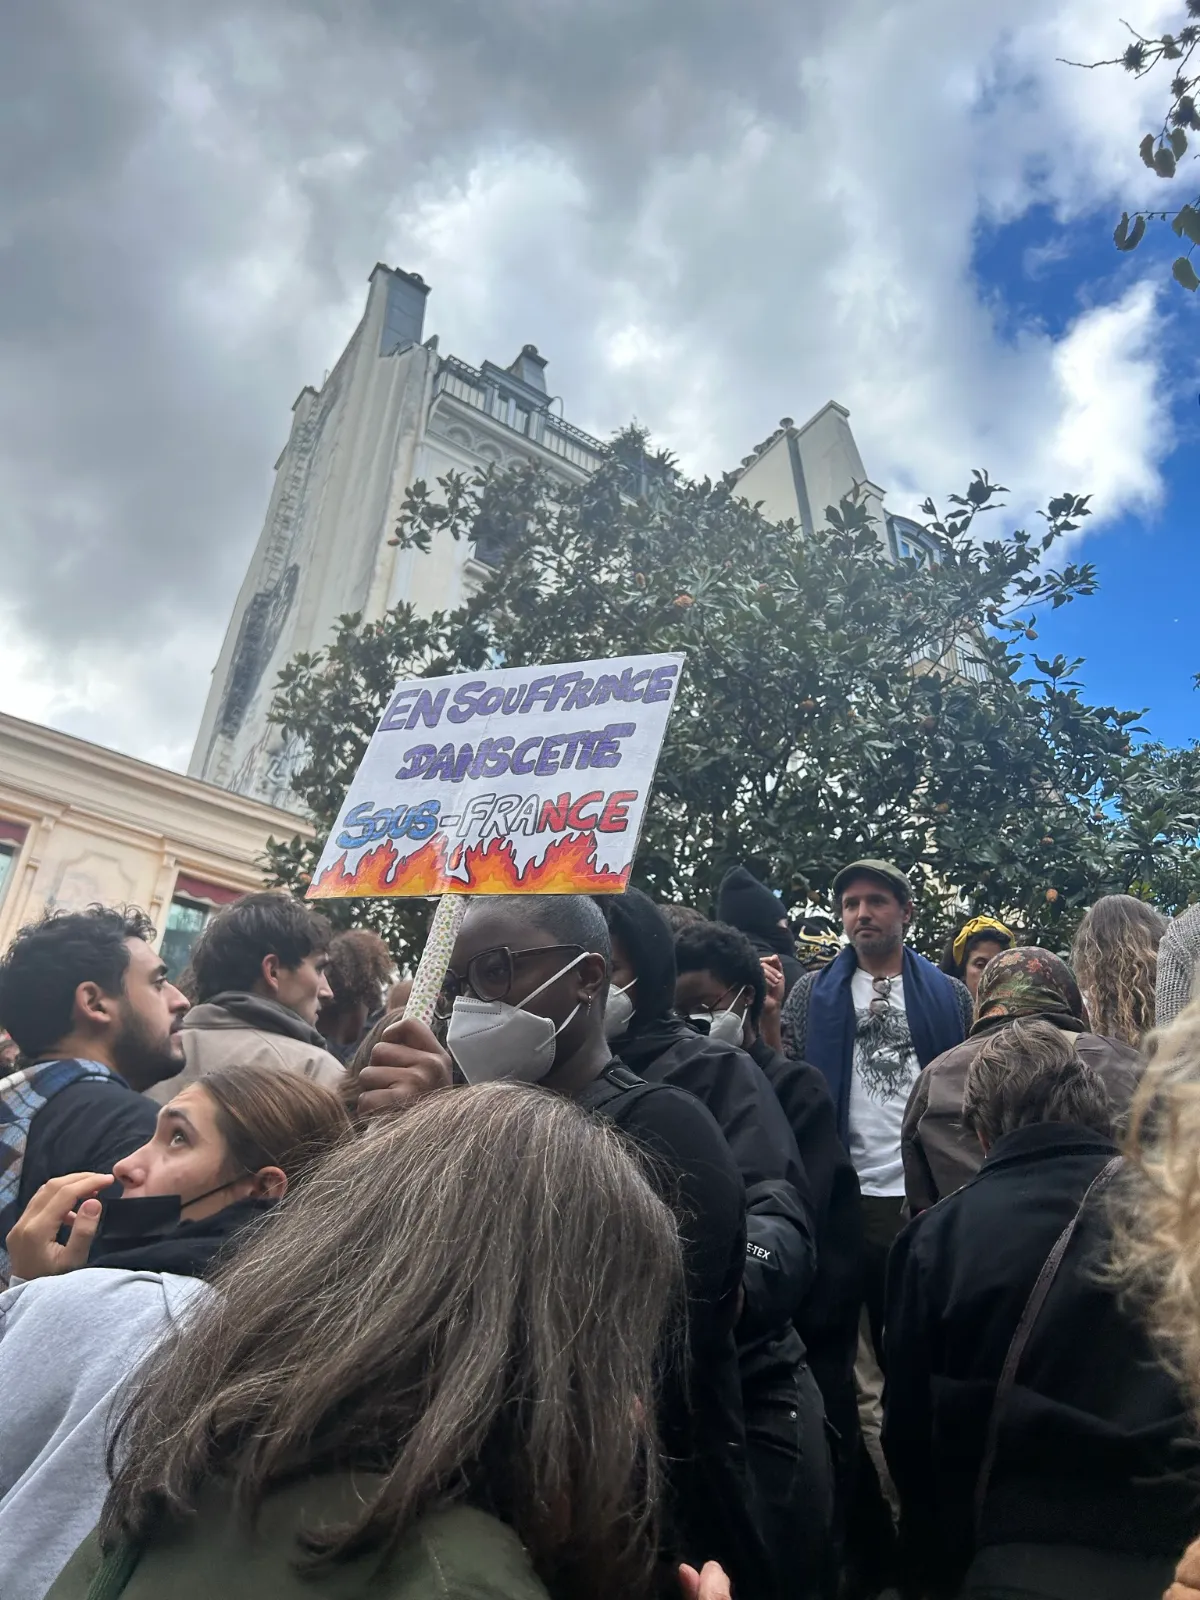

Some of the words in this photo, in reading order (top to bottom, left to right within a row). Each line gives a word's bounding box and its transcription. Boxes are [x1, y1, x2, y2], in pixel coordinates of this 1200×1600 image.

[378, 688, 451, 732] EN
[446, 664, 678, 724] SOUFFRANCE
[395, 736, 515, 783] DANS
[511, 722, 637, 777] CETTE
[334, 790, 639, 849] SOUS-FRANCE
